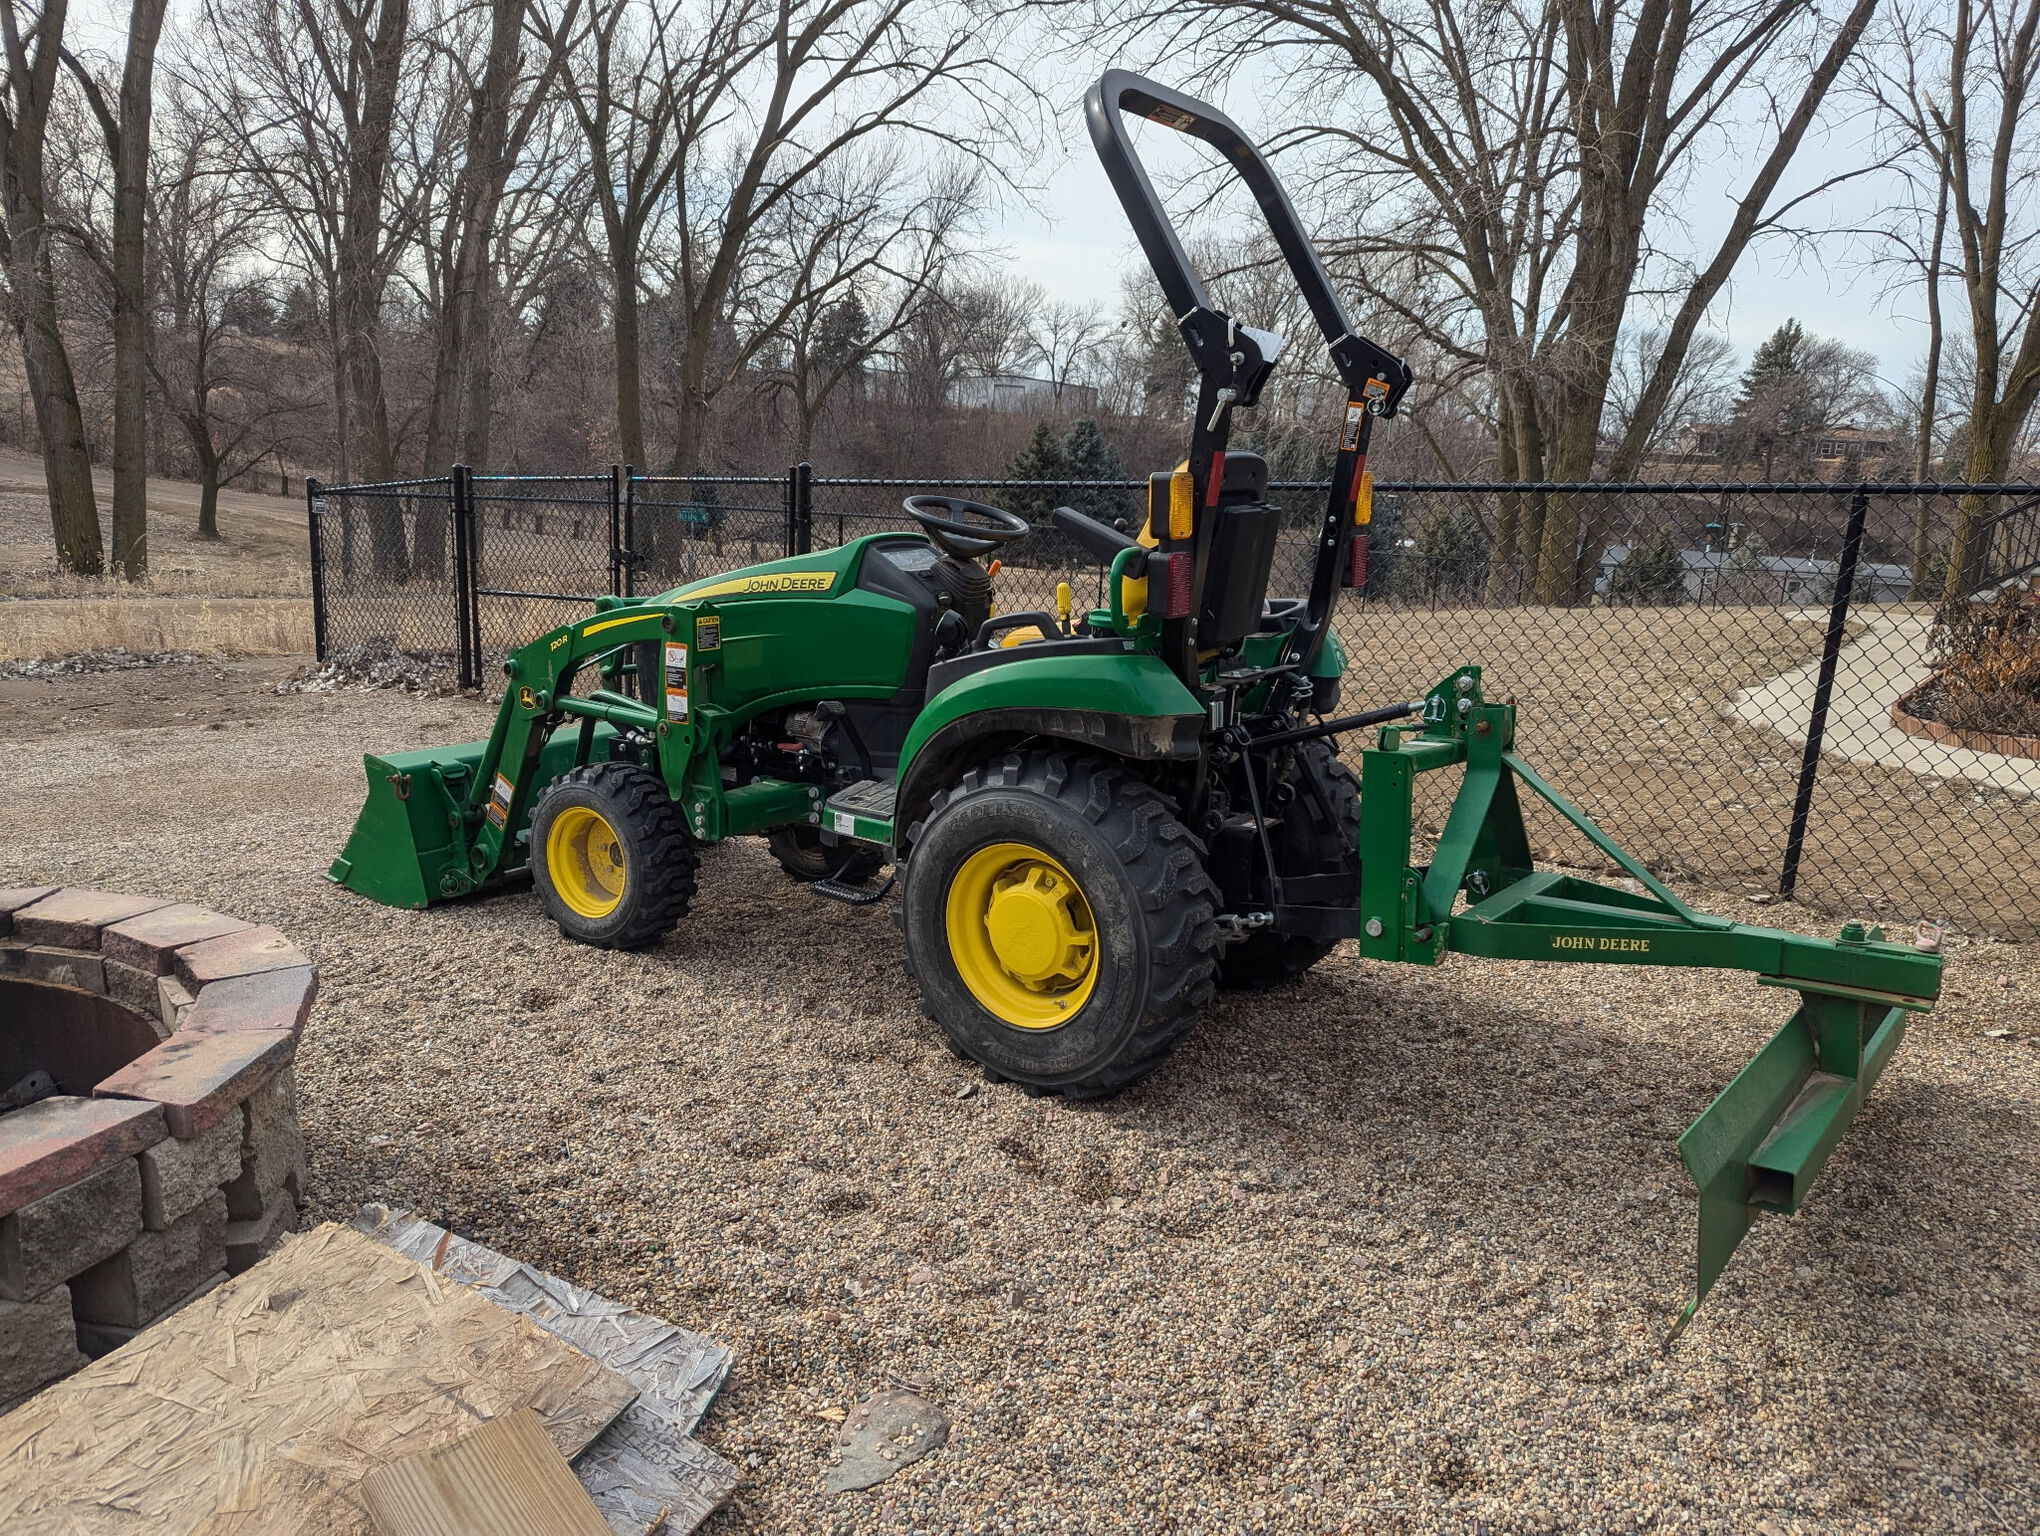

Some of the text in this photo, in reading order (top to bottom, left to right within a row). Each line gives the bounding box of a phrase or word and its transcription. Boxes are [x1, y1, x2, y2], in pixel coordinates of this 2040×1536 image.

[743, 578, 826, 592] JOHN DEERE
[1552, 936, 1650, 952] JOHN DEERE
